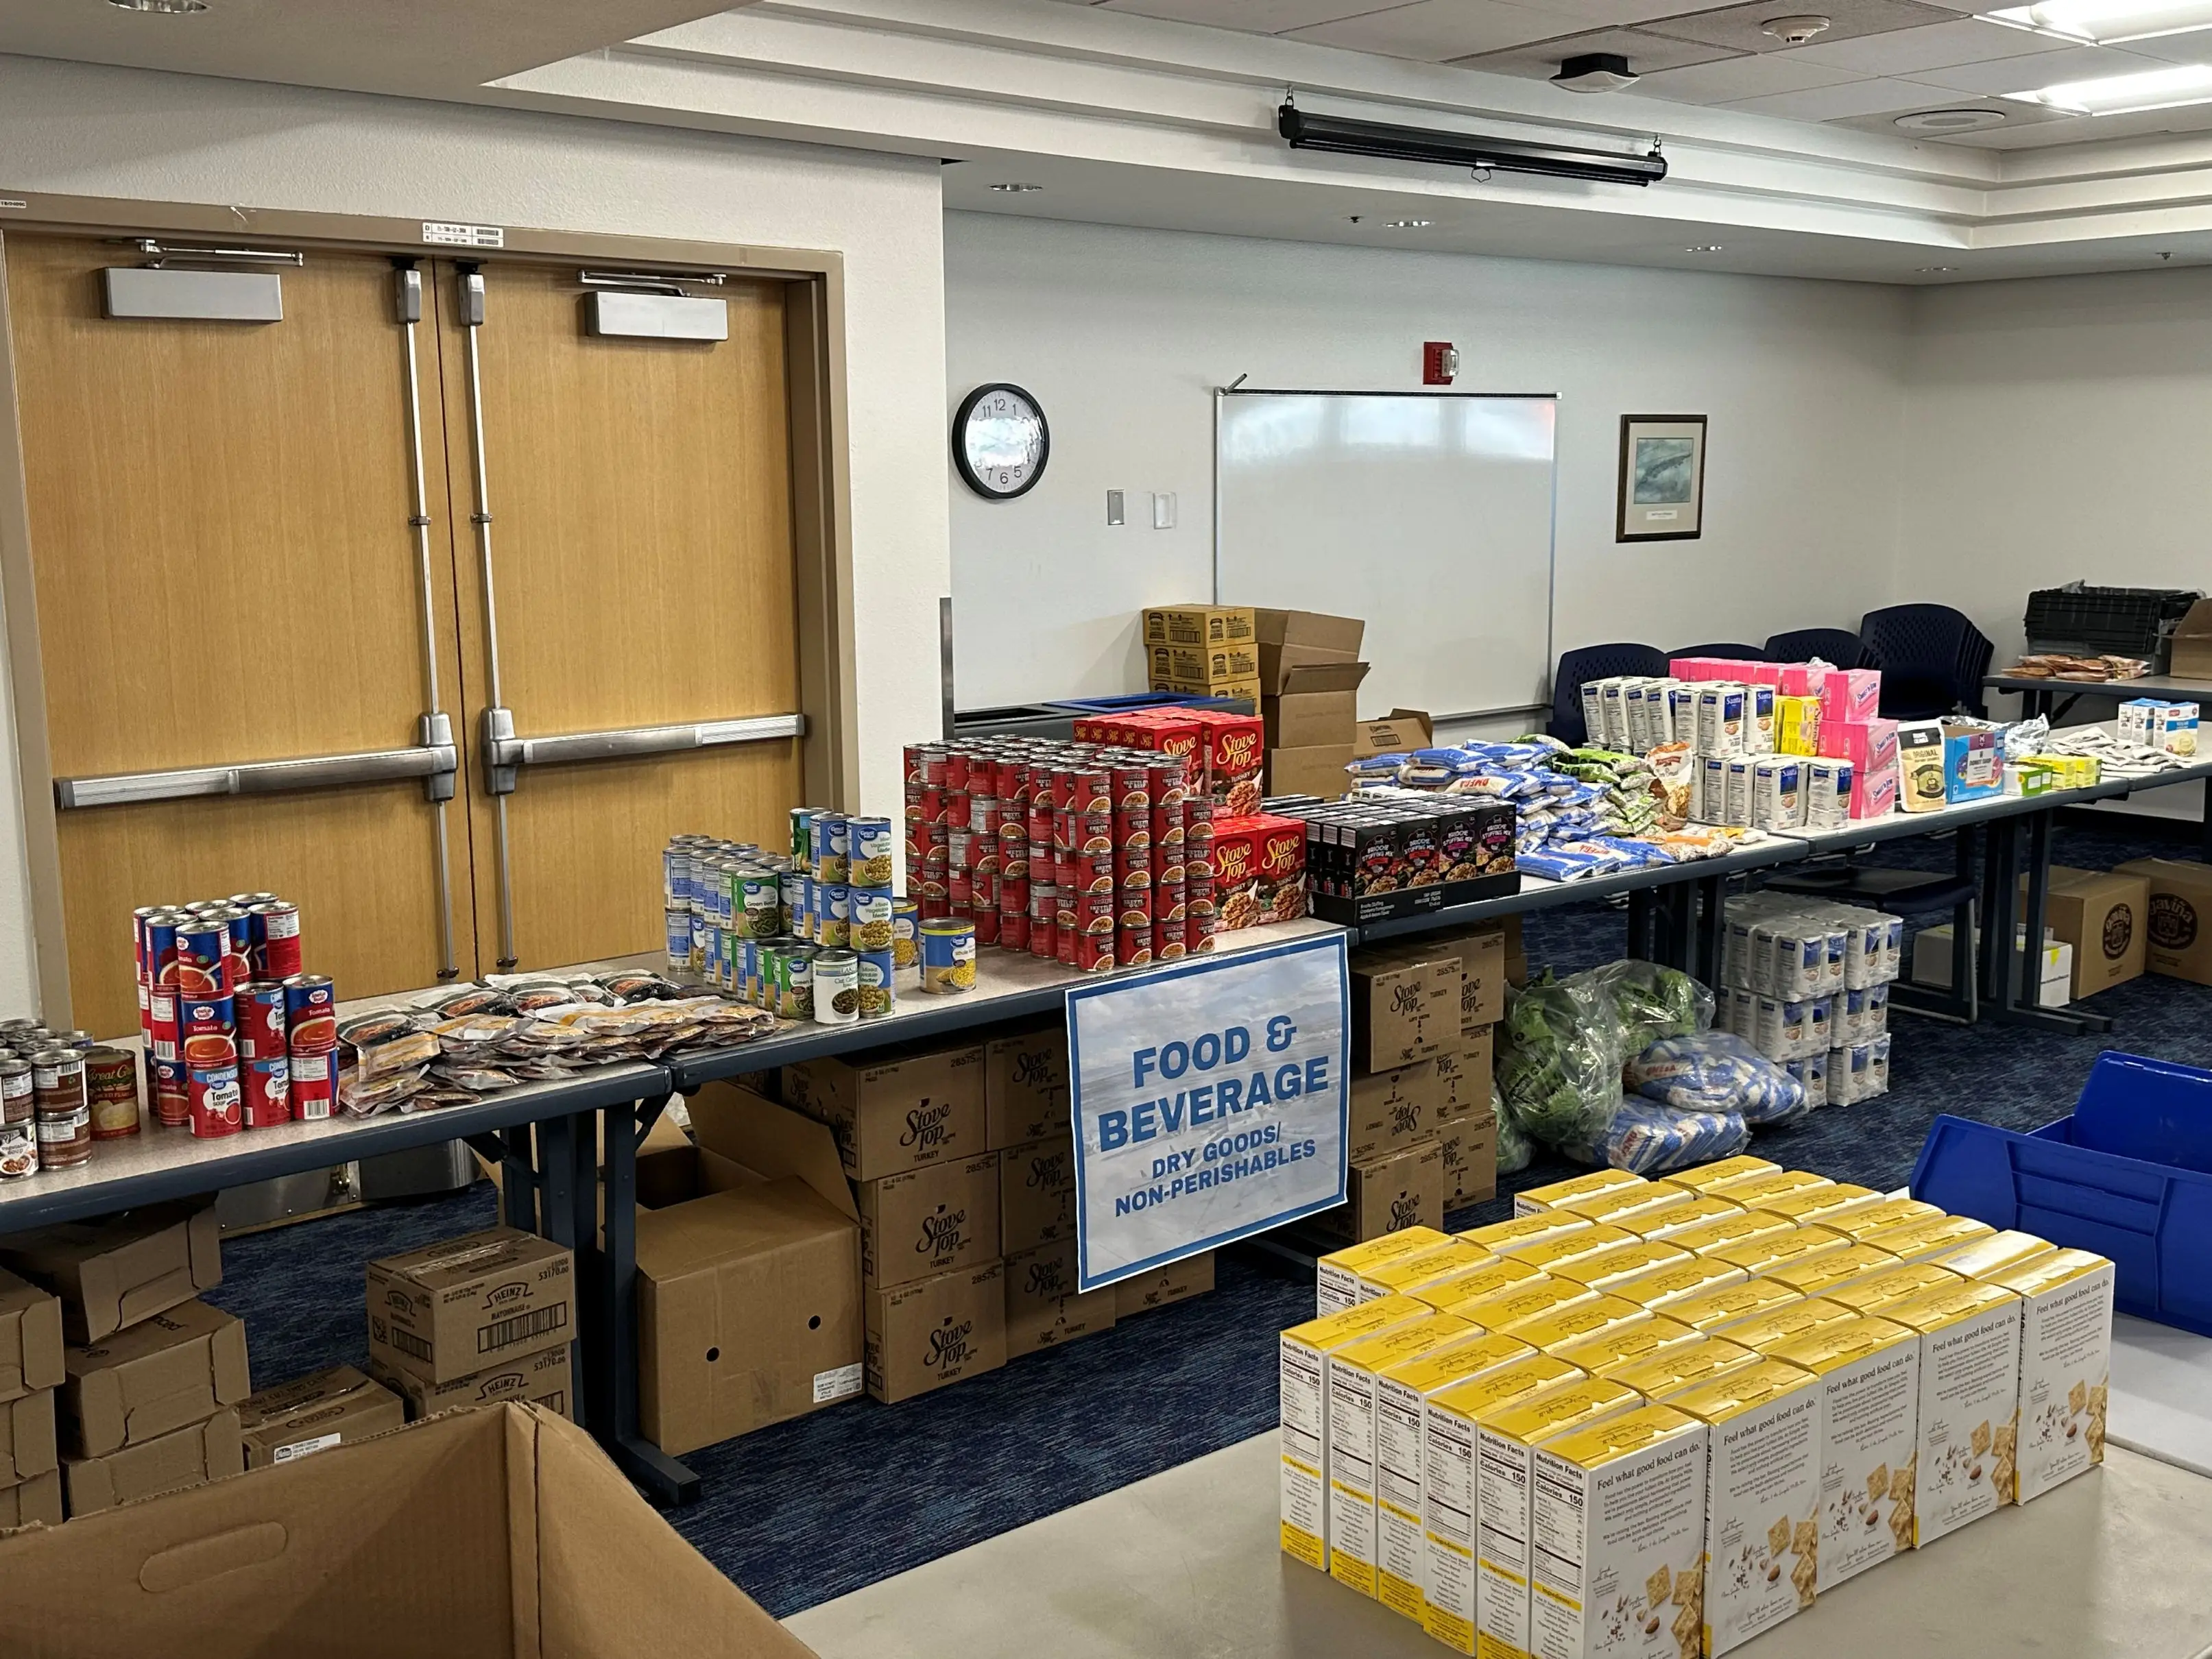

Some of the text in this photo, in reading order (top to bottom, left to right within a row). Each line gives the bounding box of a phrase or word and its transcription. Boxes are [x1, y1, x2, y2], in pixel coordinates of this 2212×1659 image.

[982, 405, 991, 417] 11
[994, 399, 1006, 411] 12
[1013, 404, 1016, 415] 1
[986, 468, 993, 480] 7
[1000, 472, 1008, 484] 6
[1014, 466, 1022, 478] 5
[1726, 697, 1742, 705] Santa
[1810, 707, 1822, 749] Splenda
[1164, 736, 1197, 755] Stove
[1216, 733, 1257, 765] Stove
[1912, 749, 1938, 758] ORIGINAL
[1231, 750, 1251, 770] Top
[1231, 771, 1250, 782] TURKEY
[1781, 768, 1798, 776] Santa
[1214, 843, 1252, 877] Stove
[1262, 836, 1300, 869] Stove
[1226, 860, 1246, 882] Top
[1276, 853, 1295, 875] Top
[1226, 883, 1245, 895] TURKEY
[1276, 873, 1295, 887] TURKEY
[1390, 982, 1422, 1012] Stove
[1402, 997, 1417, 1016] Top
[1133, 1015, 1297, 1089] FOOD &
[1012, 1048, 1053, 1082] Stove
[1027, 1066, 1048, 1087] Top
[1098, 1056, 1329, 1152] BEVERAGE
[900, 1103, 951, 1146] Stove
[917, 1125, 944, 1152] Top
[913, 1150, 939, 1163] TURKEY
[1153, 1122, 1281, 1178] DRY GOODS/
[1026, 1152, 1065, 1187] Stove
[1042, 1170, 1061, 1191] Top
[1116, 1139, 1315, 1217] NON-PERISHABLES
[1386, 1194, 1419, 1233] Stove
[915, 1209, 966, 1253] Stove
[934, 1231, 959, 1258] Top
[930, 1256, 955, 1268] TURKEY
[538, 1267, 568, 1281] 53170.00
[1024, 1257, 1063, 1293] Stove
[494, 1287, 522, 1302] HEINZ
[1039, 1276, 1059, 1297] Top
[2036, 1283, 2101, 1315] Feel what good food can
[491, 1305, 525, 1320] MAYONNAISE
[1064, 1323, 1085, 1335] TURKEY
[1933, 1341, 1946, 1353] Feel
[1947, 1335, 1963, 1346] what
[1964, 1328, 1979, 1343] good
[1980, 1322, 1994, 1335] food
[1995, 1319, 2006, 1329] can
[924, 1320, 972, 1366] Stove
[1282, 1341, 1319, 1361] Nutrition Facts
[941, 1342, 967, 1370] Top
[937, 1366, 962, 1381] TURKEY
[1282, 1365, 1320, 1385] Calories 150
[1332, 1363, 1371, 1384] Nutrition Facts
[1826, 1382, 1840, 1395] Feel
[1842, 1377, 1858, 1388] what
[1860, 1368, 1876, 1383] good
[1877, 1361, 1891, 1374] food
[1892, 1358, 1903, 1368] can
[488, 1379, 516, 1394] HEINZ
[1379, 1380, 1419, 1403] Nutrition Facts
[1332, 1388, 1371, 1409] Calories 150
[1379, 1405, 1420, 1427] Calories 150
[1428, 1409, 1470, 1433] Nutrition Facts
[1724, 1431, 1738, 1446] Feel
[1740, 1425, 1757, 1438] what
[1759, 1415, 1775, 1432] good
[1776, 1408, 1791, 1422] food
[1792, 1403, 1805, 1415] can
[1428, 1435, 1471, 1458] Calories 150
[1480, 1433, 1524, 1457] Nutrition Facts
[1480, 1460, 1526, 1484] Calories 150
[1536, 1453, 1583, 1479] Nutrition Facts
[1597, 1476, 1613, 1490] Feel
[1615, 1469, 1635, 1483] what
[1637, 1460, 1655, 1476] good
[1656, 1453, 1672, 1467] food
[1674, 1447, 1687, 1459] can
[1536, 1481, 1583, 1507] Calories 150
